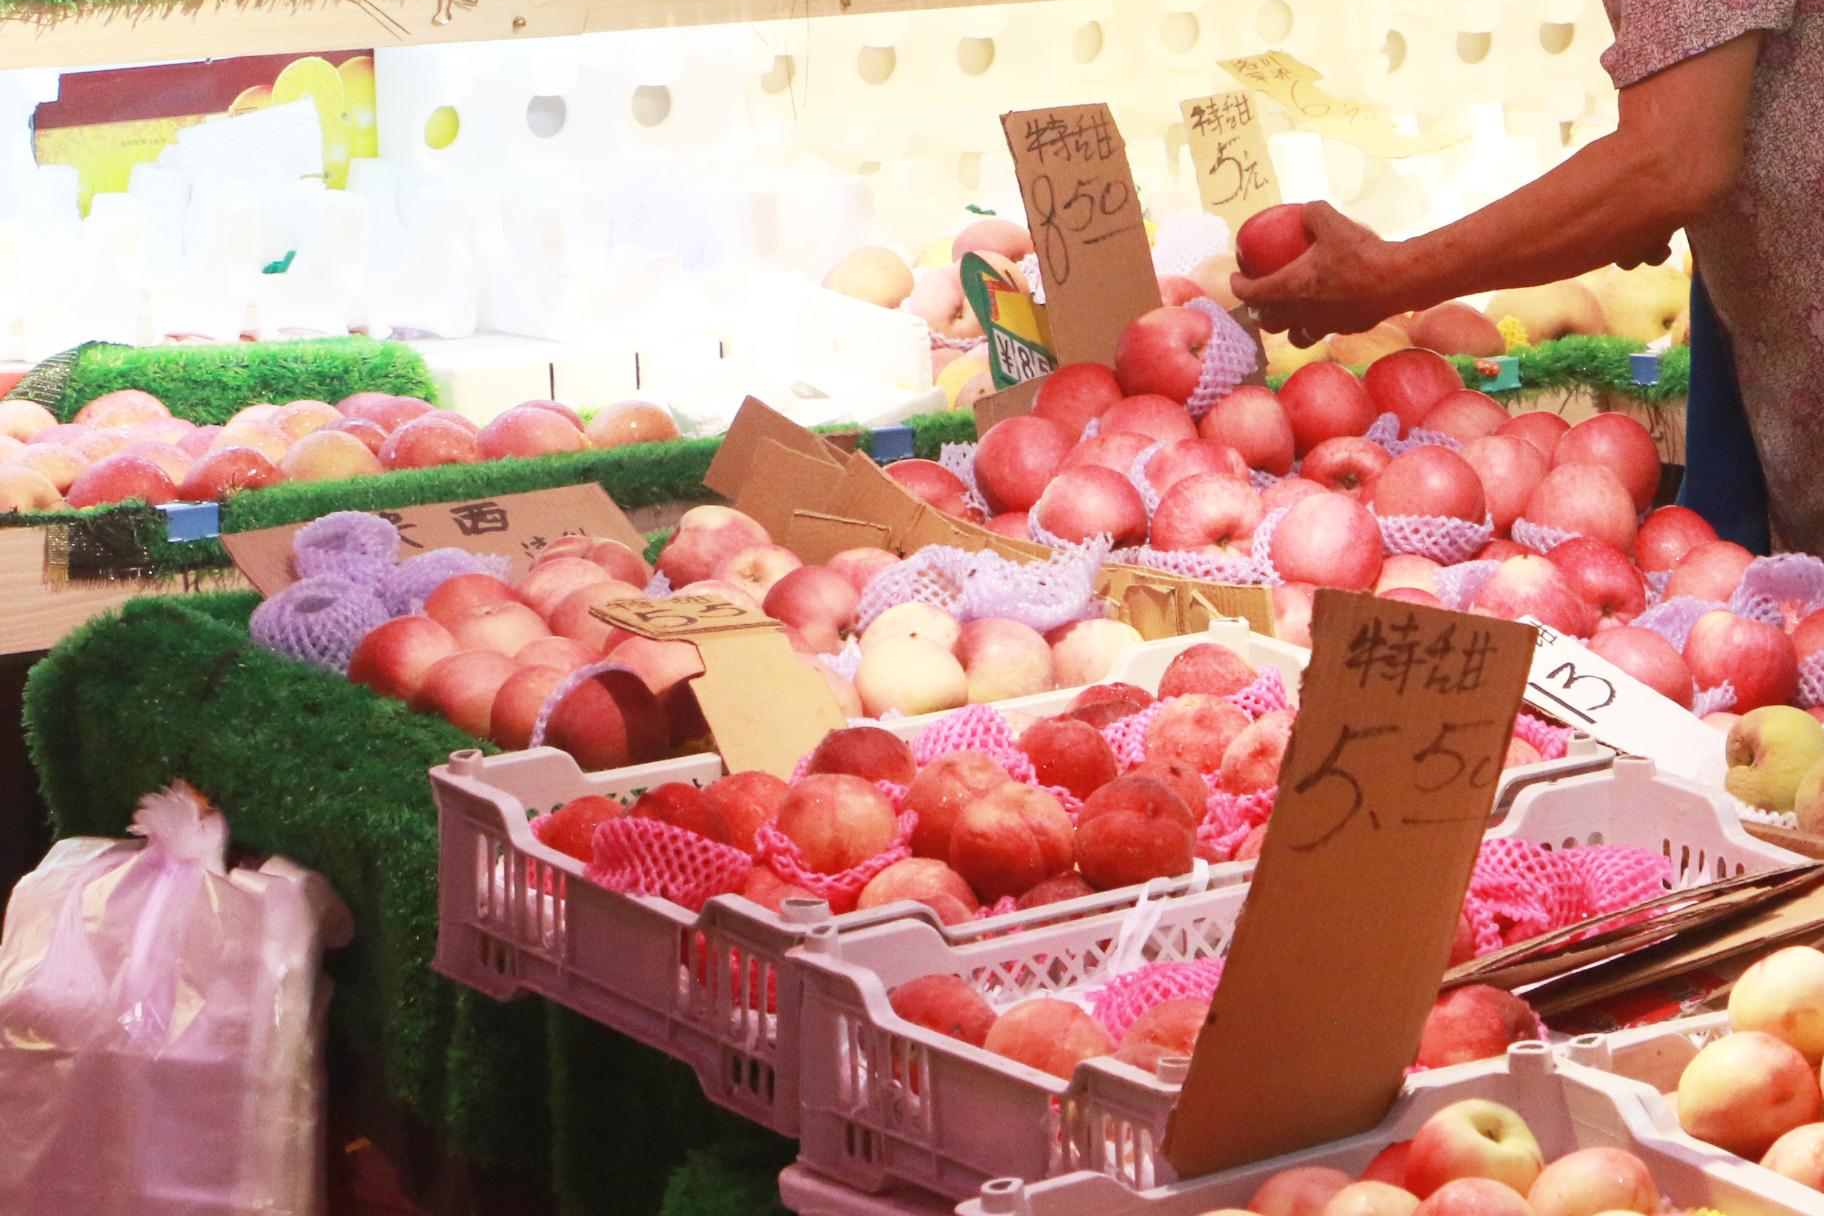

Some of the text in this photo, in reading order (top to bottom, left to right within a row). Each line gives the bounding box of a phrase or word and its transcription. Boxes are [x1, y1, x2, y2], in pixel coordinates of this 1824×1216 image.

[1024, 109, 1117, 165] 特甜
[1190, 94, 1252, 136] 特甜
[1345, 612, 1498, 695] 特甜
